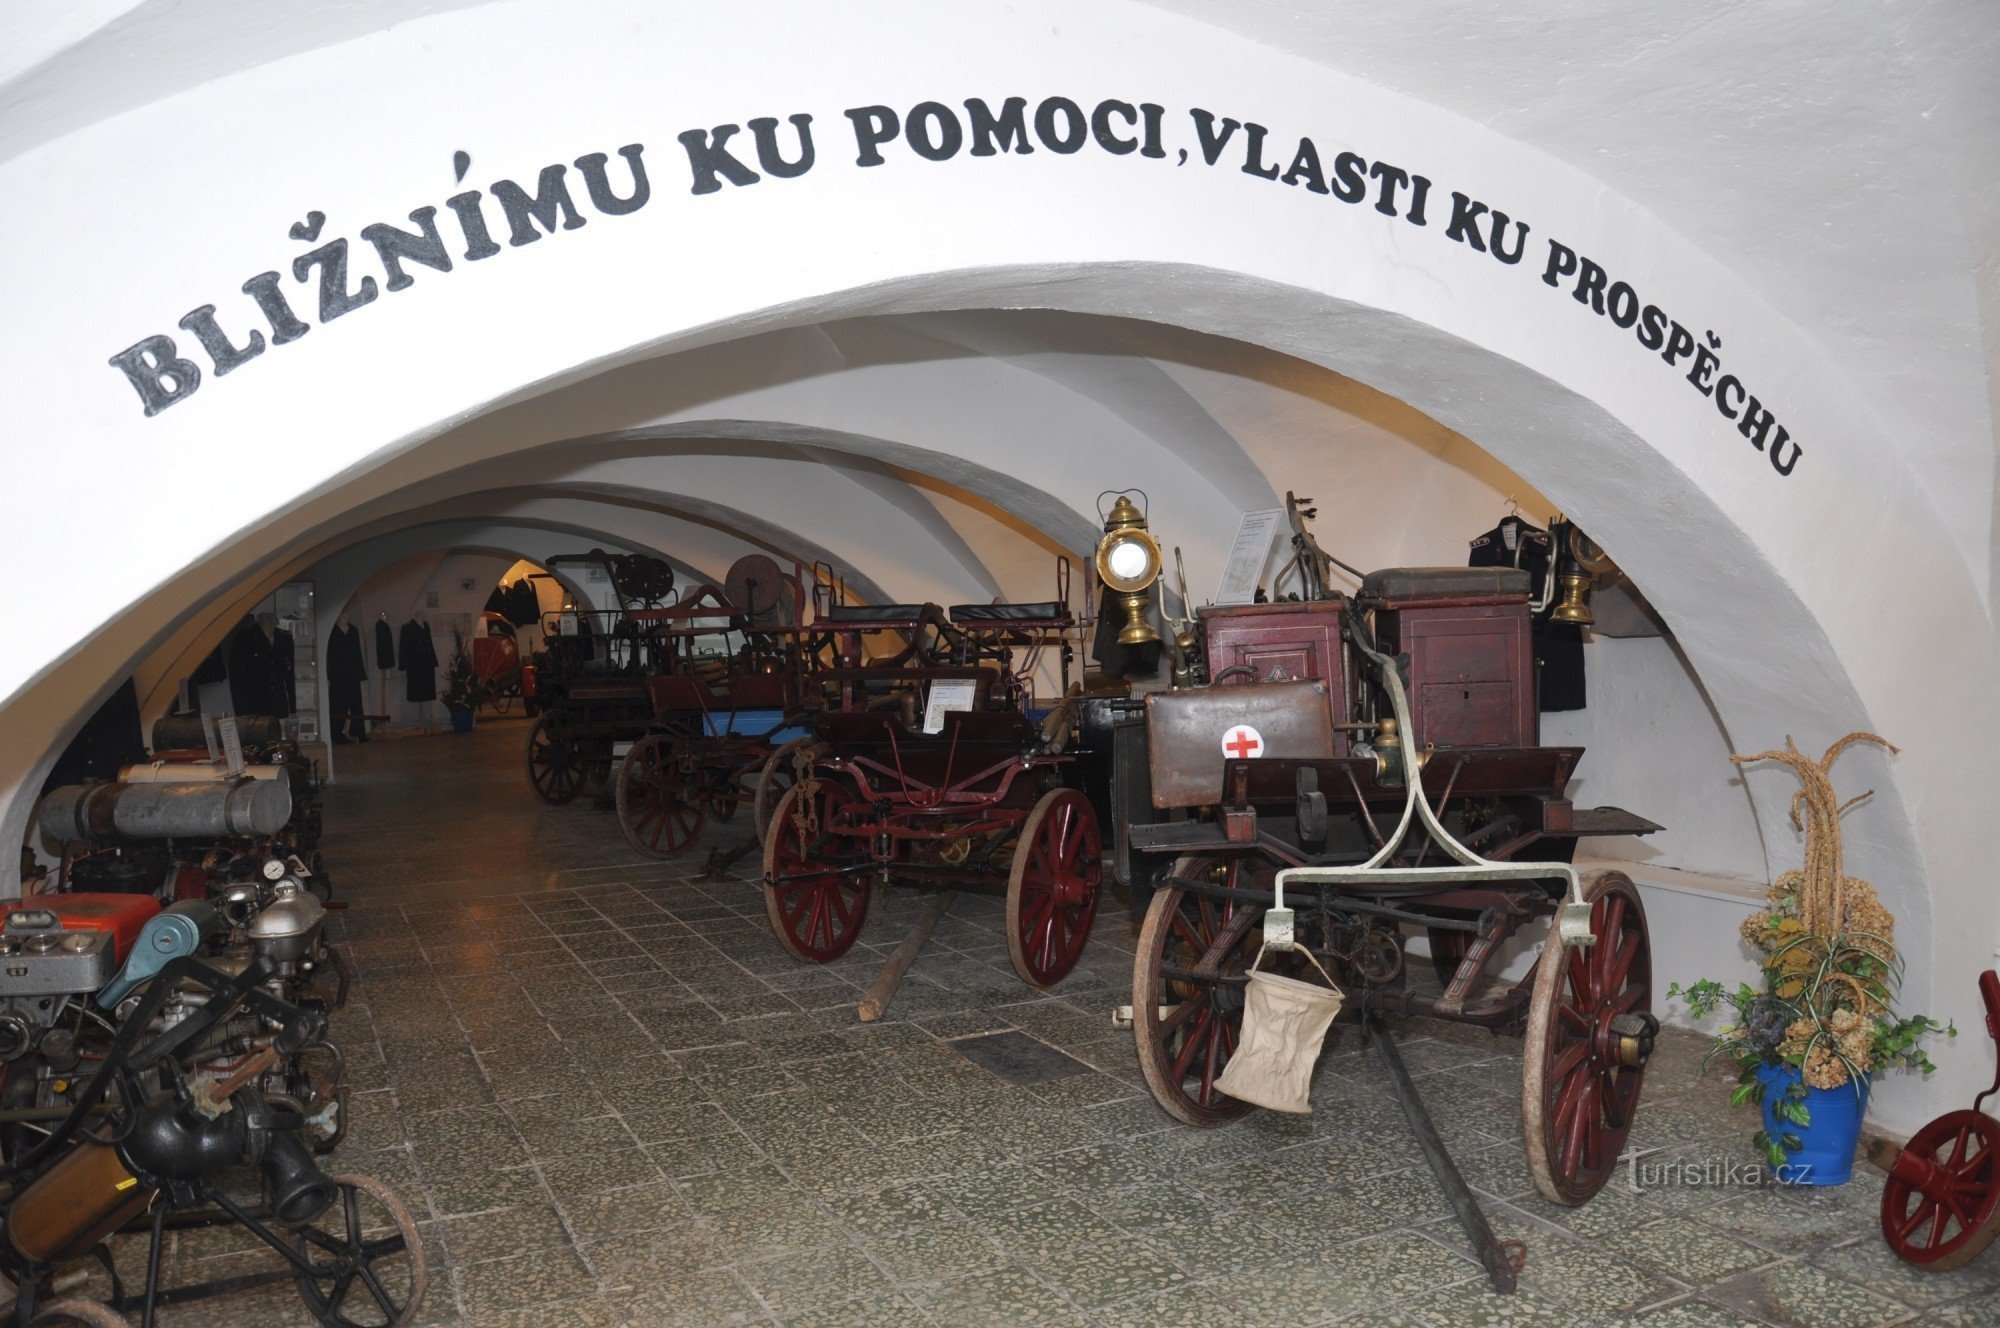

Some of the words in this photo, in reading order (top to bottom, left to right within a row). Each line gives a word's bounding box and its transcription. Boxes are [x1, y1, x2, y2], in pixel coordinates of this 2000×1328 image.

[108, 143, 651, 418] BLIŽNÍMU
[677, 114, 816, 195] KU
[1445, 190, 1532, 265] KU
[1541, 238, 1803, 477] PROSPĚCHU
